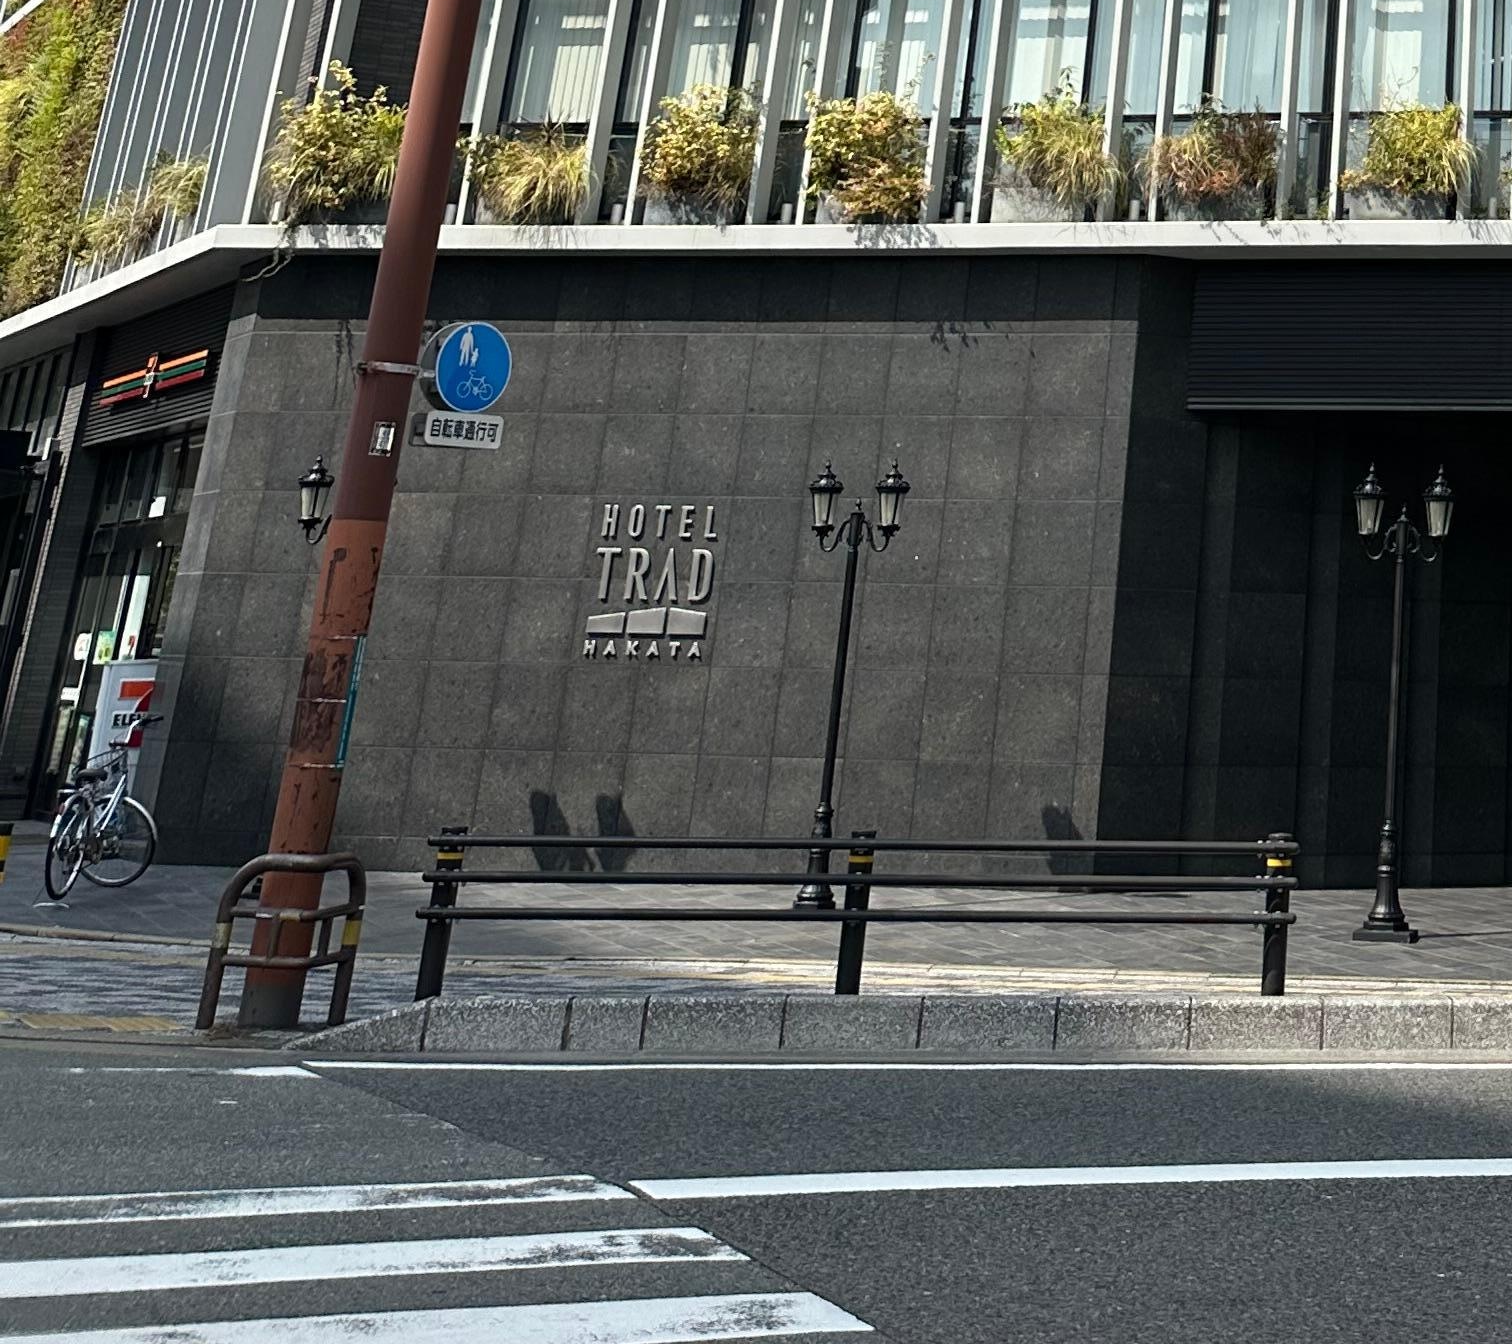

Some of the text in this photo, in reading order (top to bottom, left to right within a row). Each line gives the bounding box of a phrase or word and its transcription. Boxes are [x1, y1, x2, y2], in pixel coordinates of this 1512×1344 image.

[429, 417, 499, 443] 自転車通行可
[600, 503, 719, 541] HOTEL
[595, 546, 715, 605] TRAD
[582, 638, 703, 660] HAKATA
